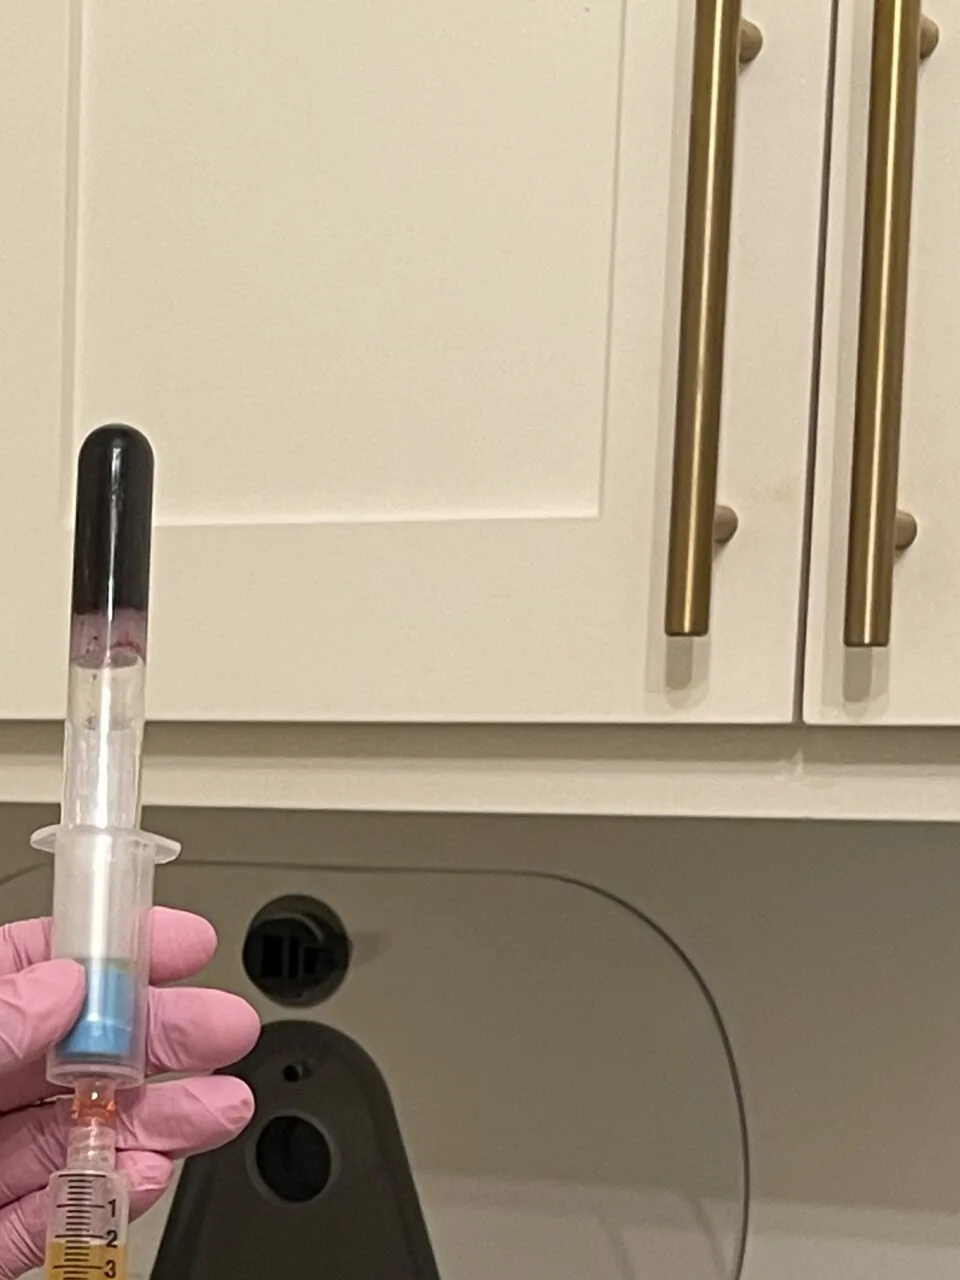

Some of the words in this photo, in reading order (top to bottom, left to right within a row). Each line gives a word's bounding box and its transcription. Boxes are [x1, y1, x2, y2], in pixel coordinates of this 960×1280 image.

[108, 1198, 116, 1218] 1
[106, 1229, 118, 1248] 2
[104, 1259, 116, 1279] 3
